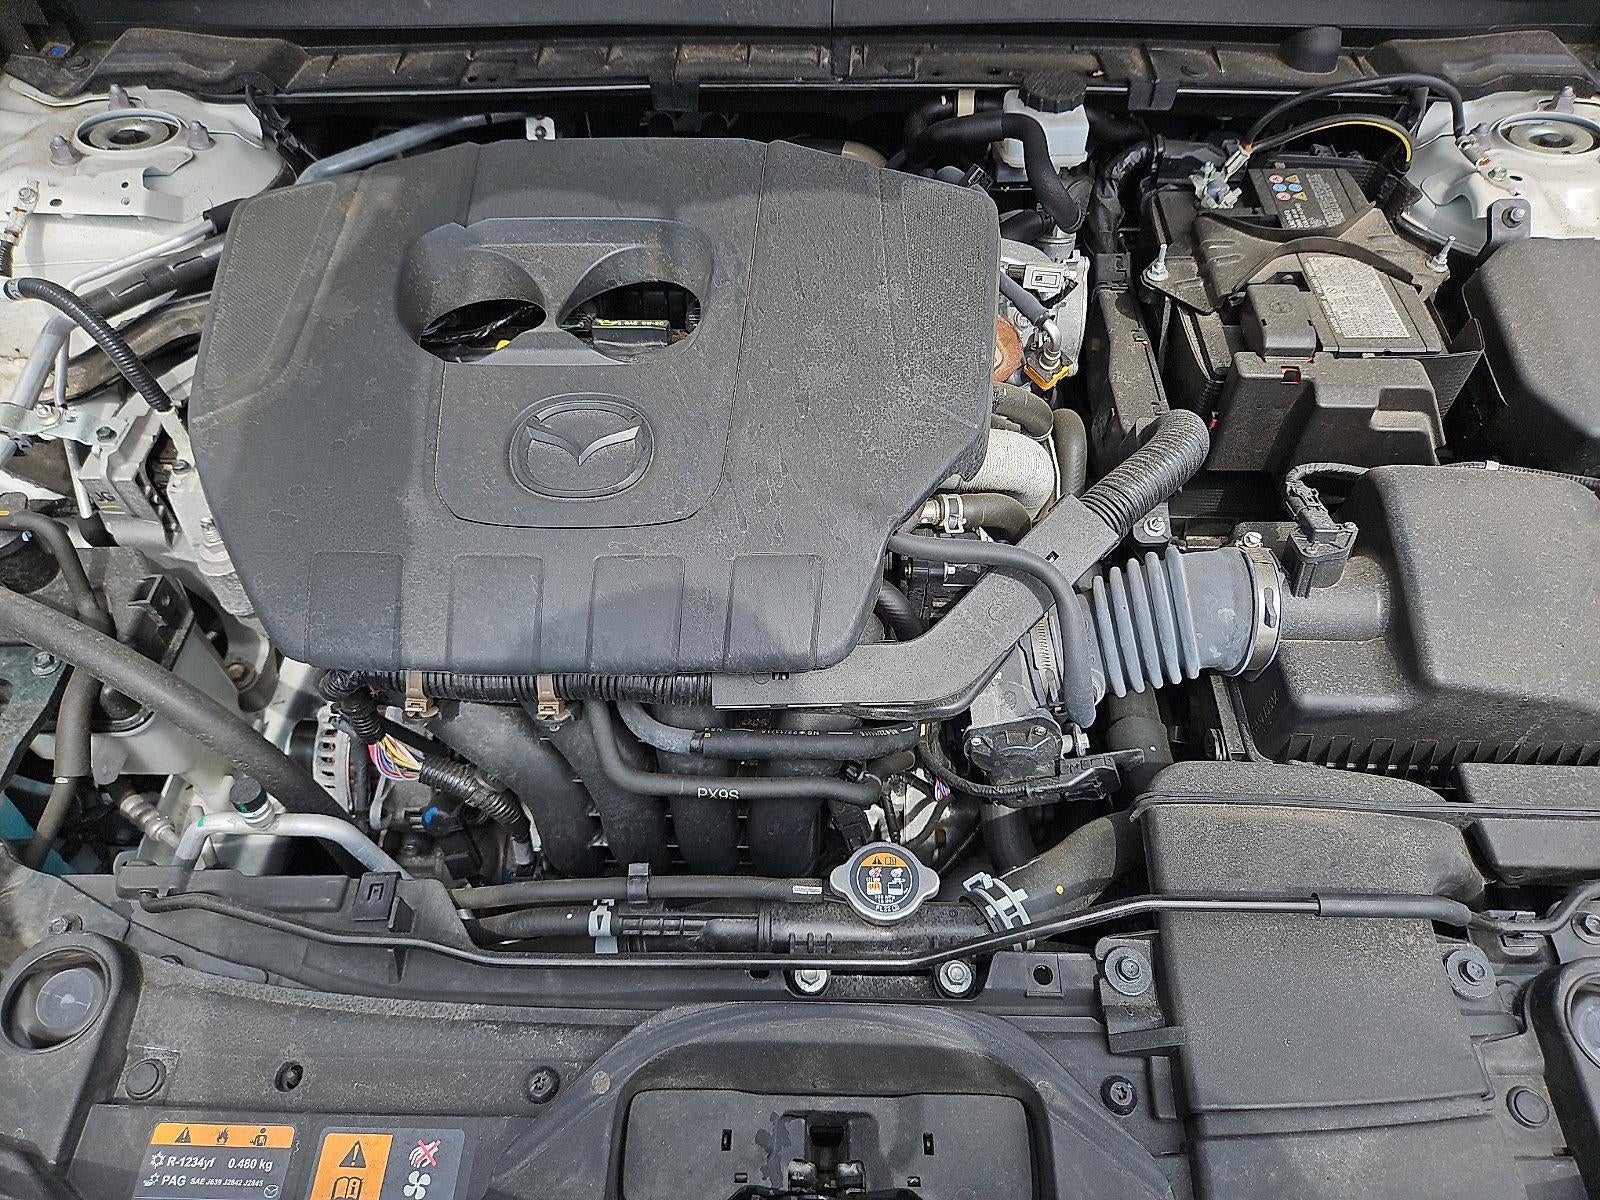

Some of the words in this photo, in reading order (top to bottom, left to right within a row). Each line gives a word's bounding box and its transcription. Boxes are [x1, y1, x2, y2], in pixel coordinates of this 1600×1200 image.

[167, 1156, 216, 1170] R-1234yf
[227, 1158, 257, 1169] 0.480
[259, 1158, 274, 1172] kg
[161, 1175, 187, 1186] PAG
